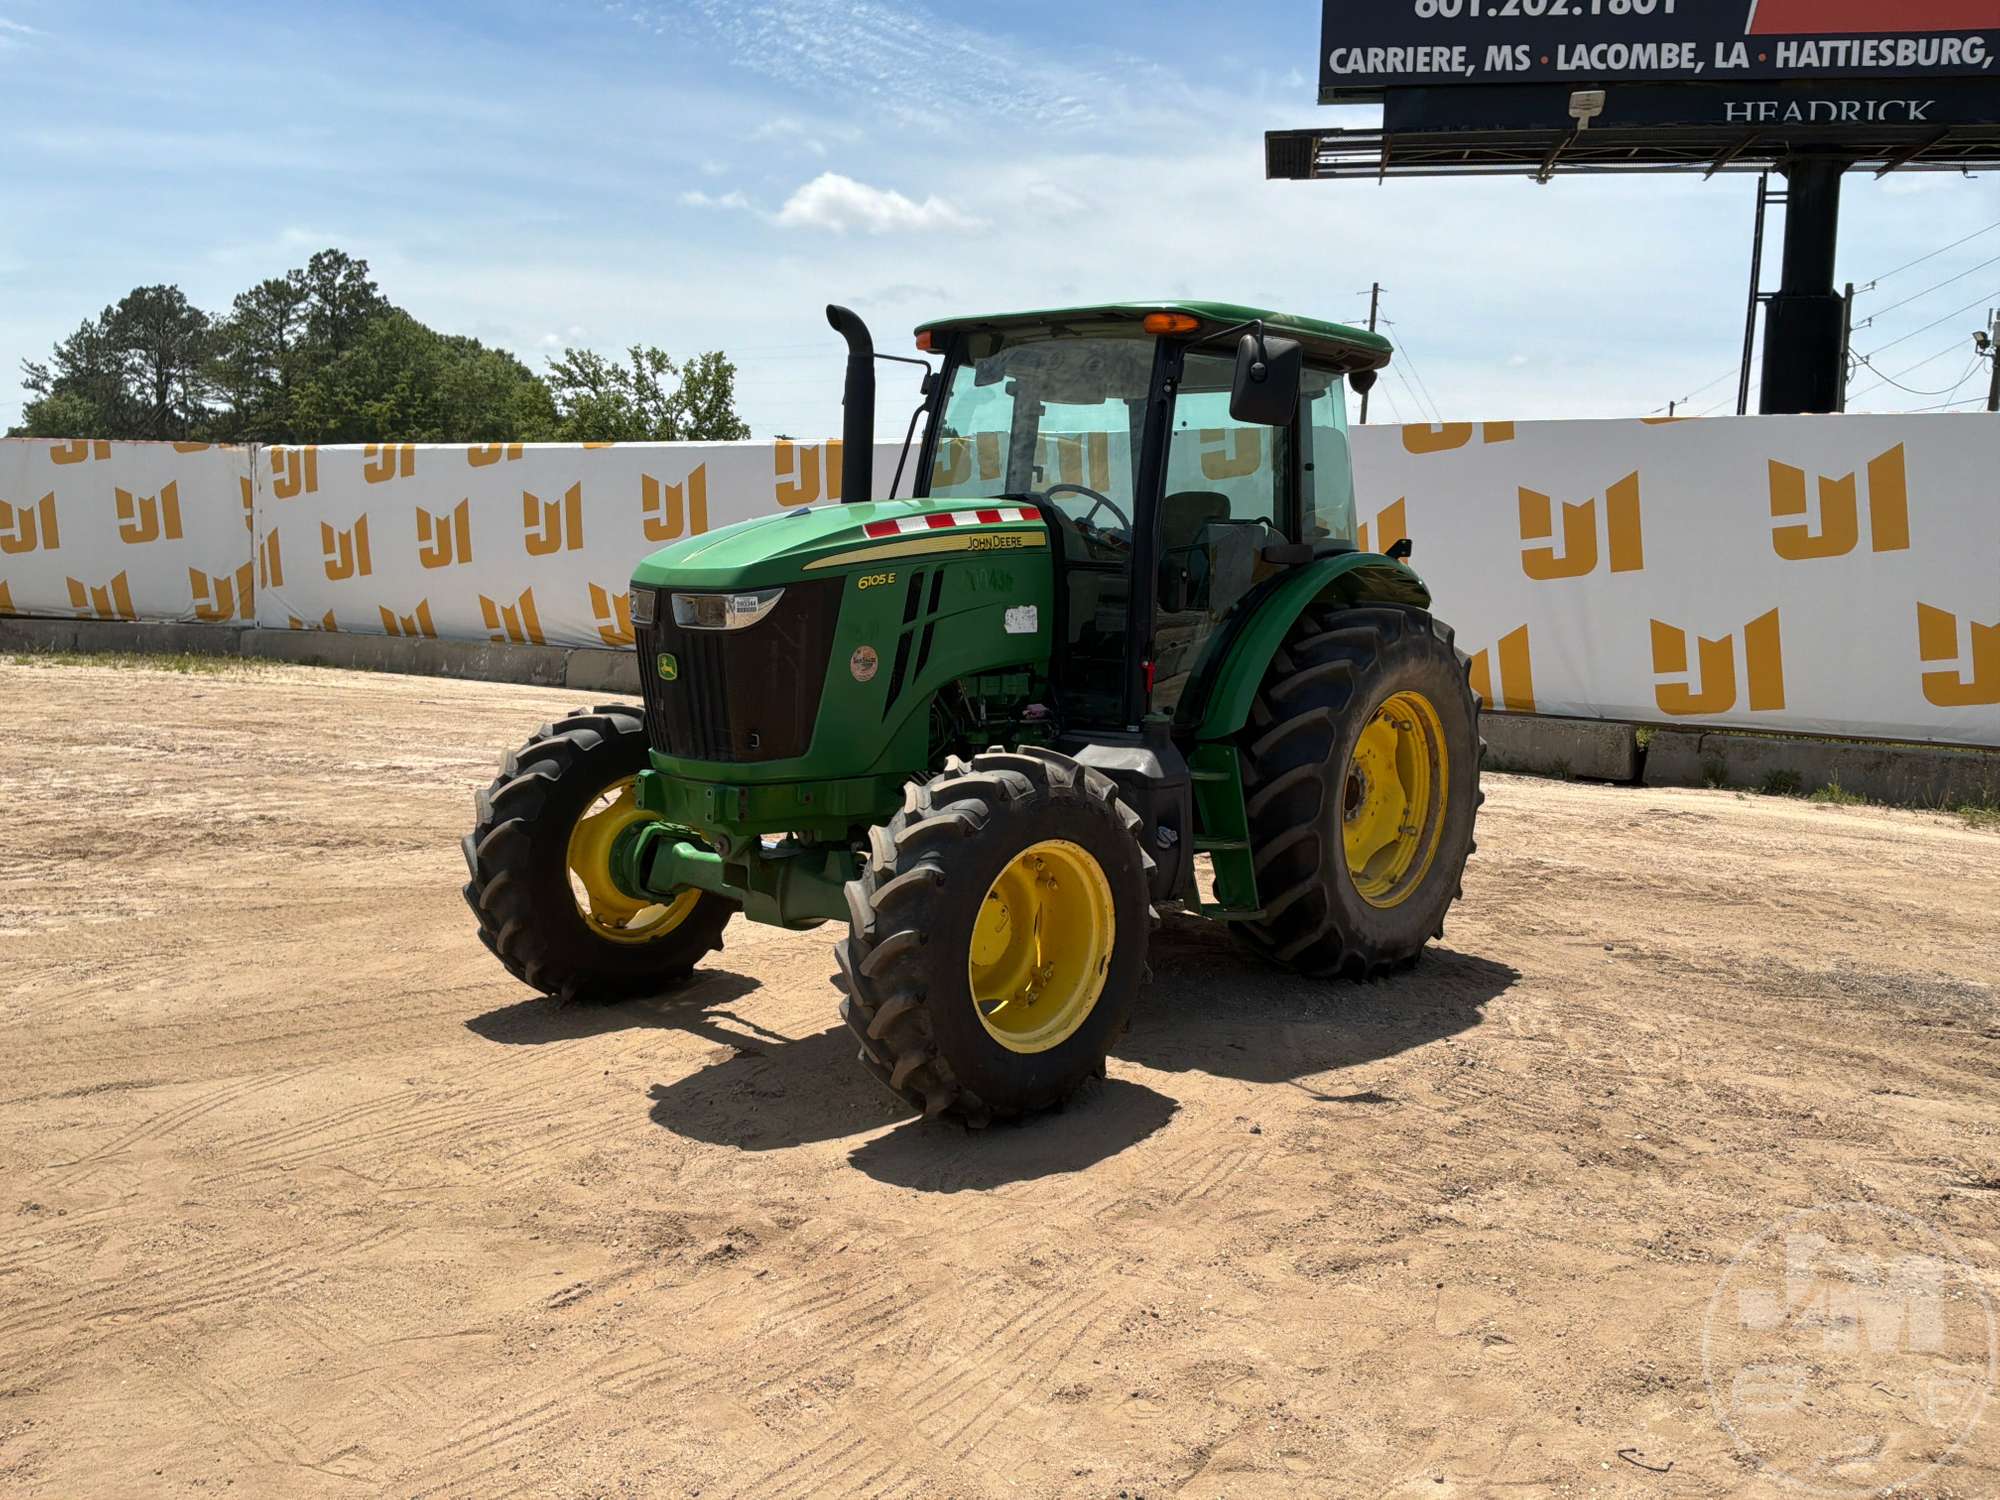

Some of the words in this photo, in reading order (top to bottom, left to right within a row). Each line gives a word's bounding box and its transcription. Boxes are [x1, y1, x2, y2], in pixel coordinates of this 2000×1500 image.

[1329, 45, 1476, 77] CARRIERE,
[1484, 45, 1531, 72] MS
[1556, 42, 1706, 74] LACOMBE,
[1714, 42, 1750, 69] LA
[1776, 36, 1993, 70] HATTIESBURG,
[1723, 100, 1936, 121] HEADRICK
[967, 536, 992, 550] JOHN
[992, 535, 1023, 548] DEERE
